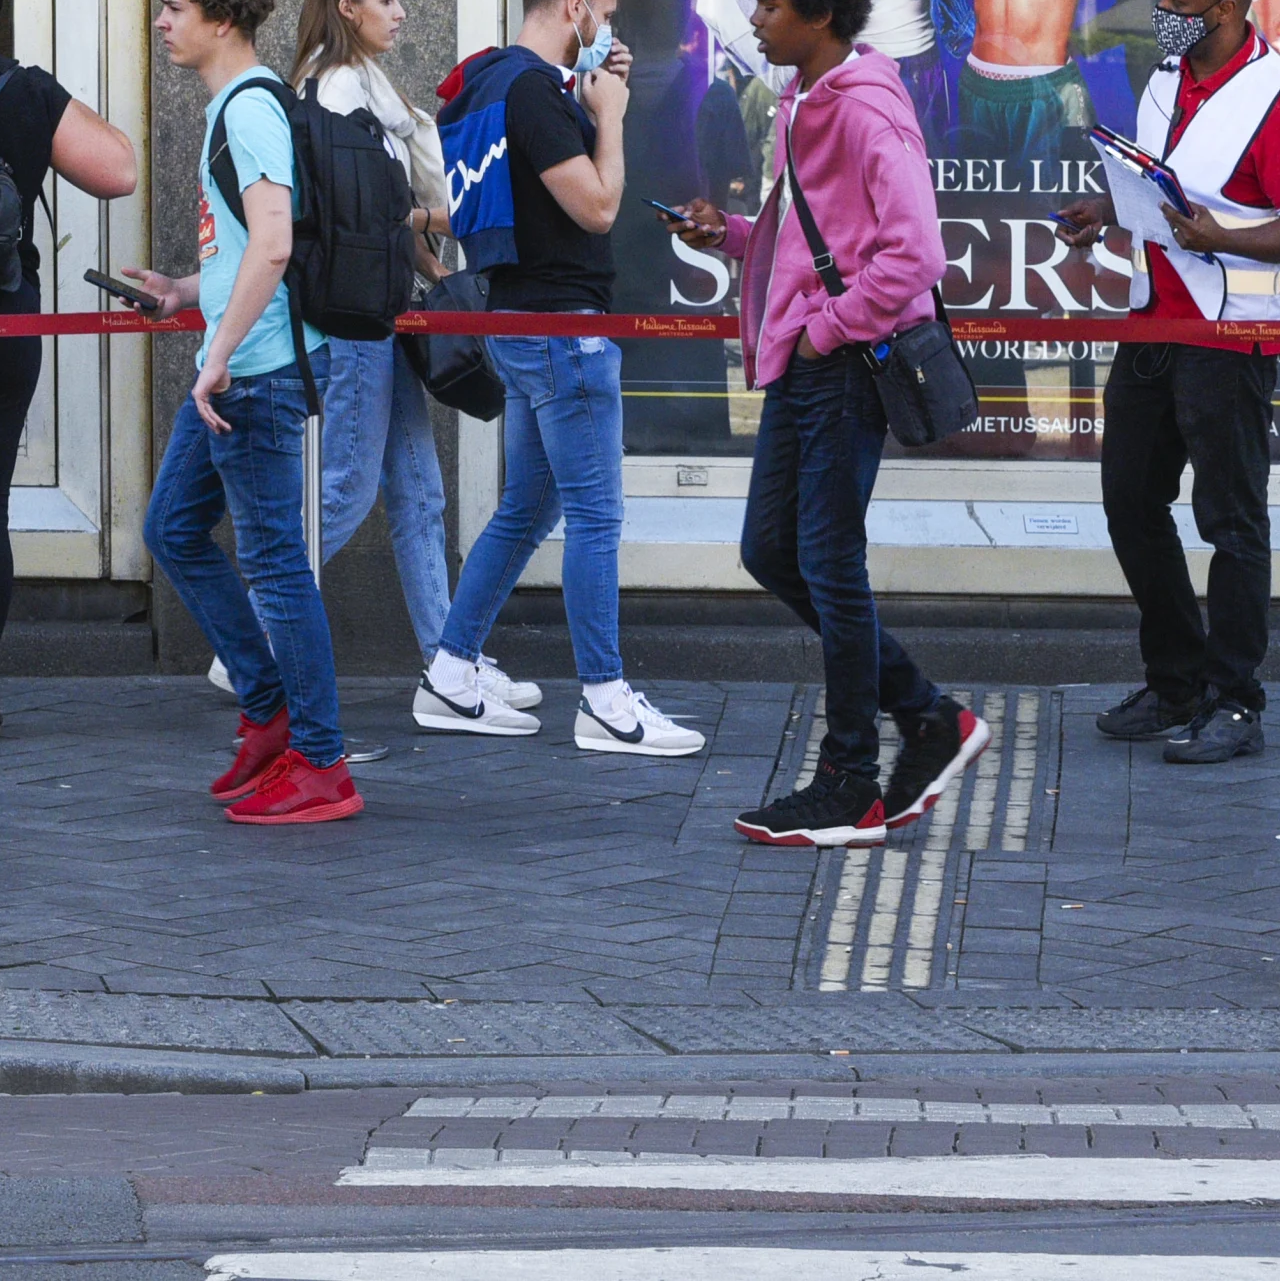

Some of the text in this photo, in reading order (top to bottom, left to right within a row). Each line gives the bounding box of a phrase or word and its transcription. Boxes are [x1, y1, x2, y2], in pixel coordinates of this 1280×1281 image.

[927, 158, 1106, 194] EEL LIK
[394, 313, 428, 328] ussauds
[634, 316, 717, 332] Madame Tussauds
[965, 321, 1008, 334] Tussauds
[1216, 321, 1257, 336] Madame
